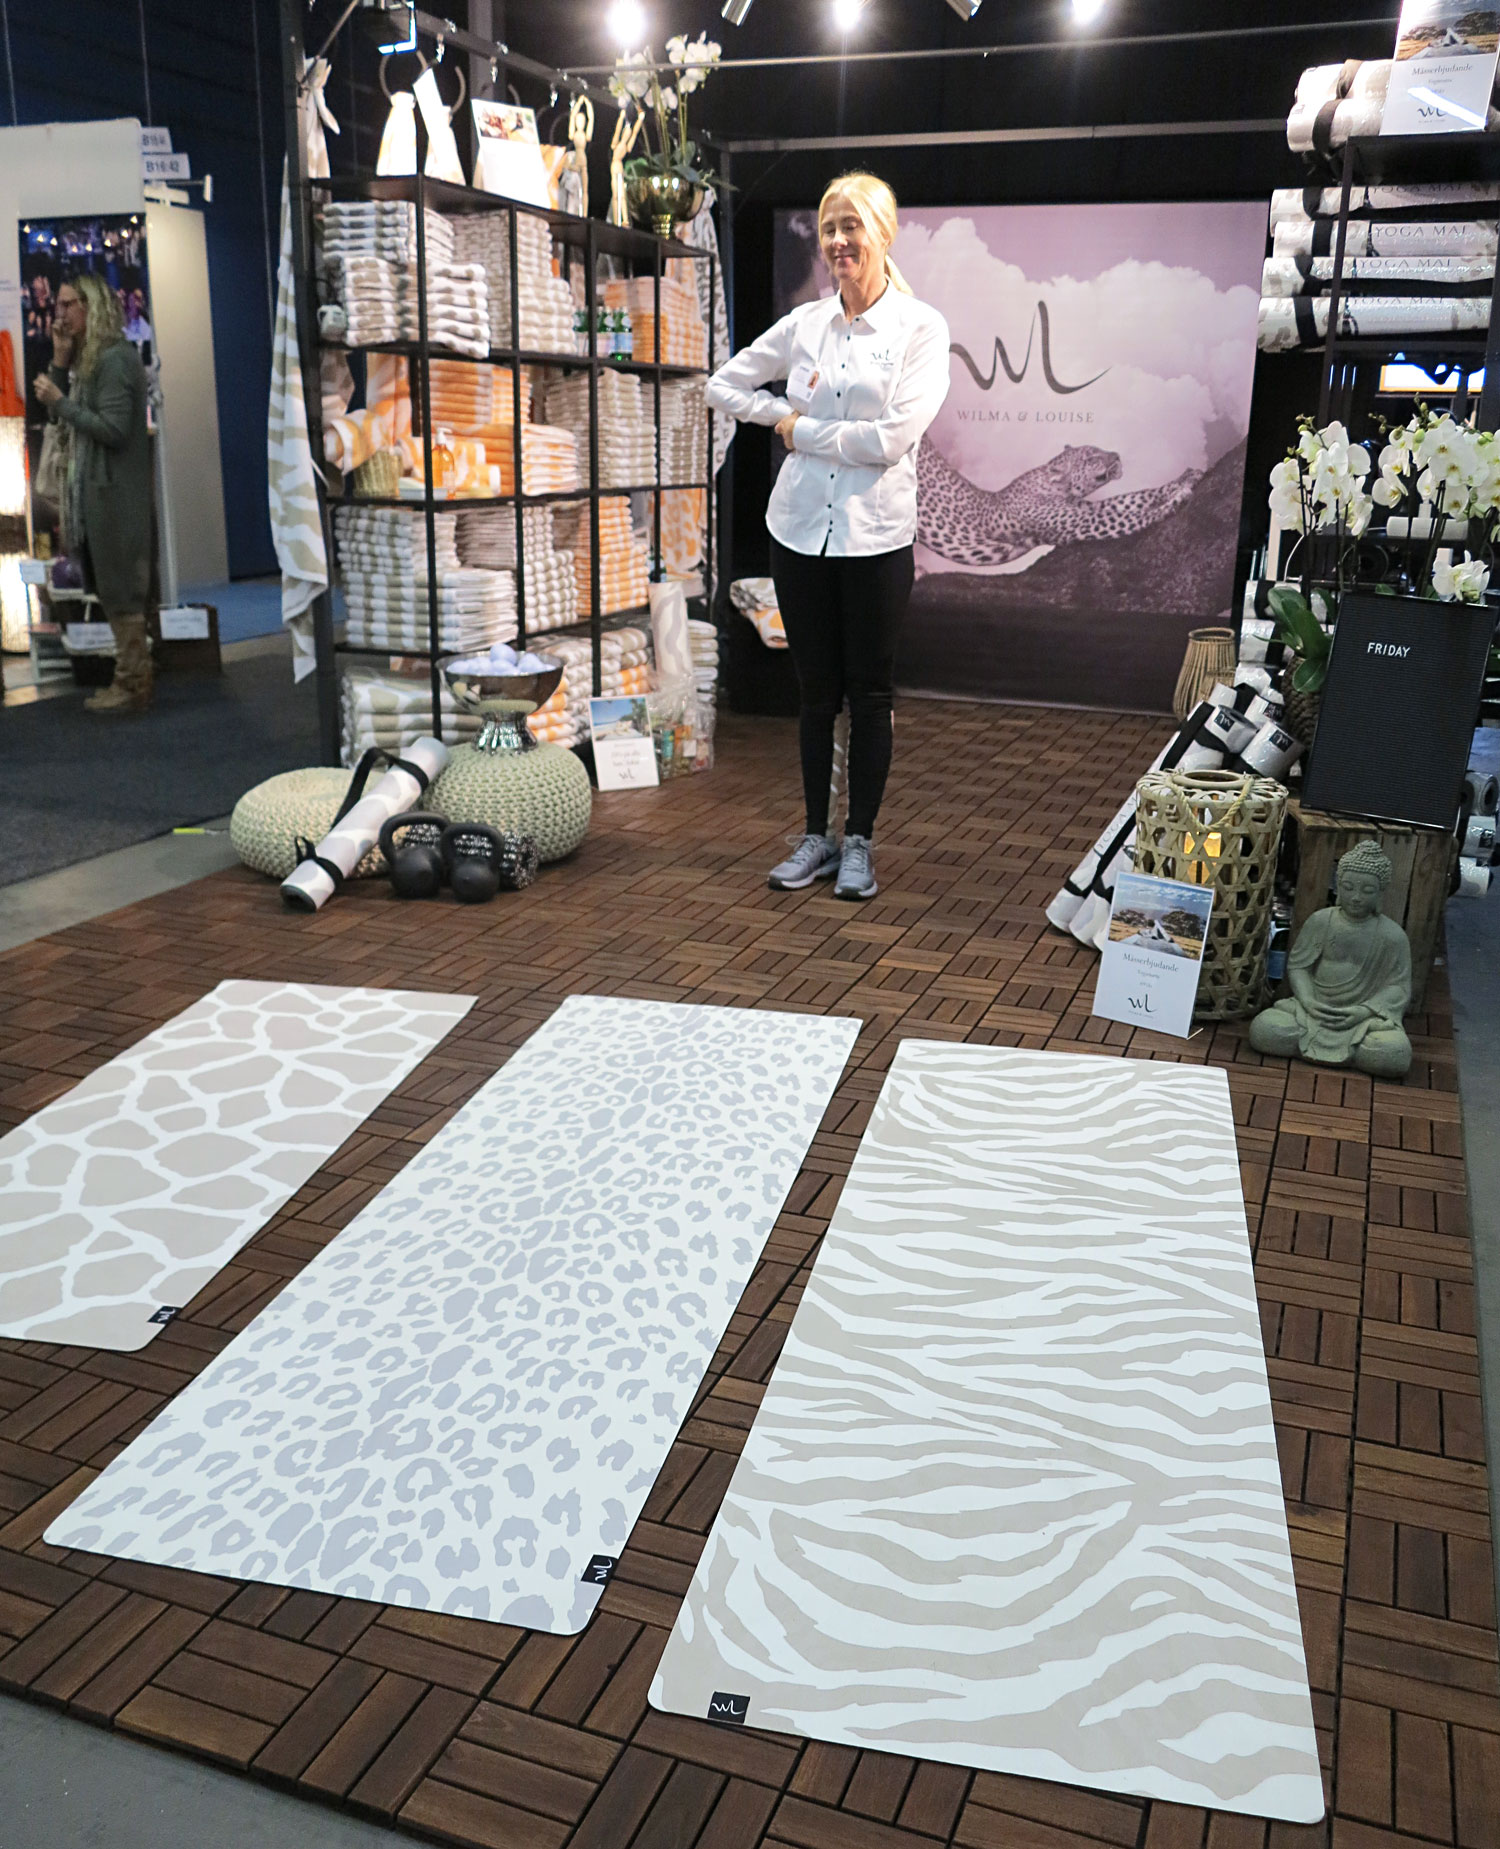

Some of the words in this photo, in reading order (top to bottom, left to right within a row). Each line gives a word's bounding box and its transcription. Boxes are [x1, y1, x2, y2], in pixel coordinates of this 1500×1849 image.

[1375, 226, 1424, 238] YOGA
[1360, 258, 1409, 269] YOGA
[957, 410, 1010, 422] WILMA
[1017, 411, 1028, 422] &
[1036, 411, 1095, 423] LOUISE
[1367, 641, 1411, 658] FRIDAY
